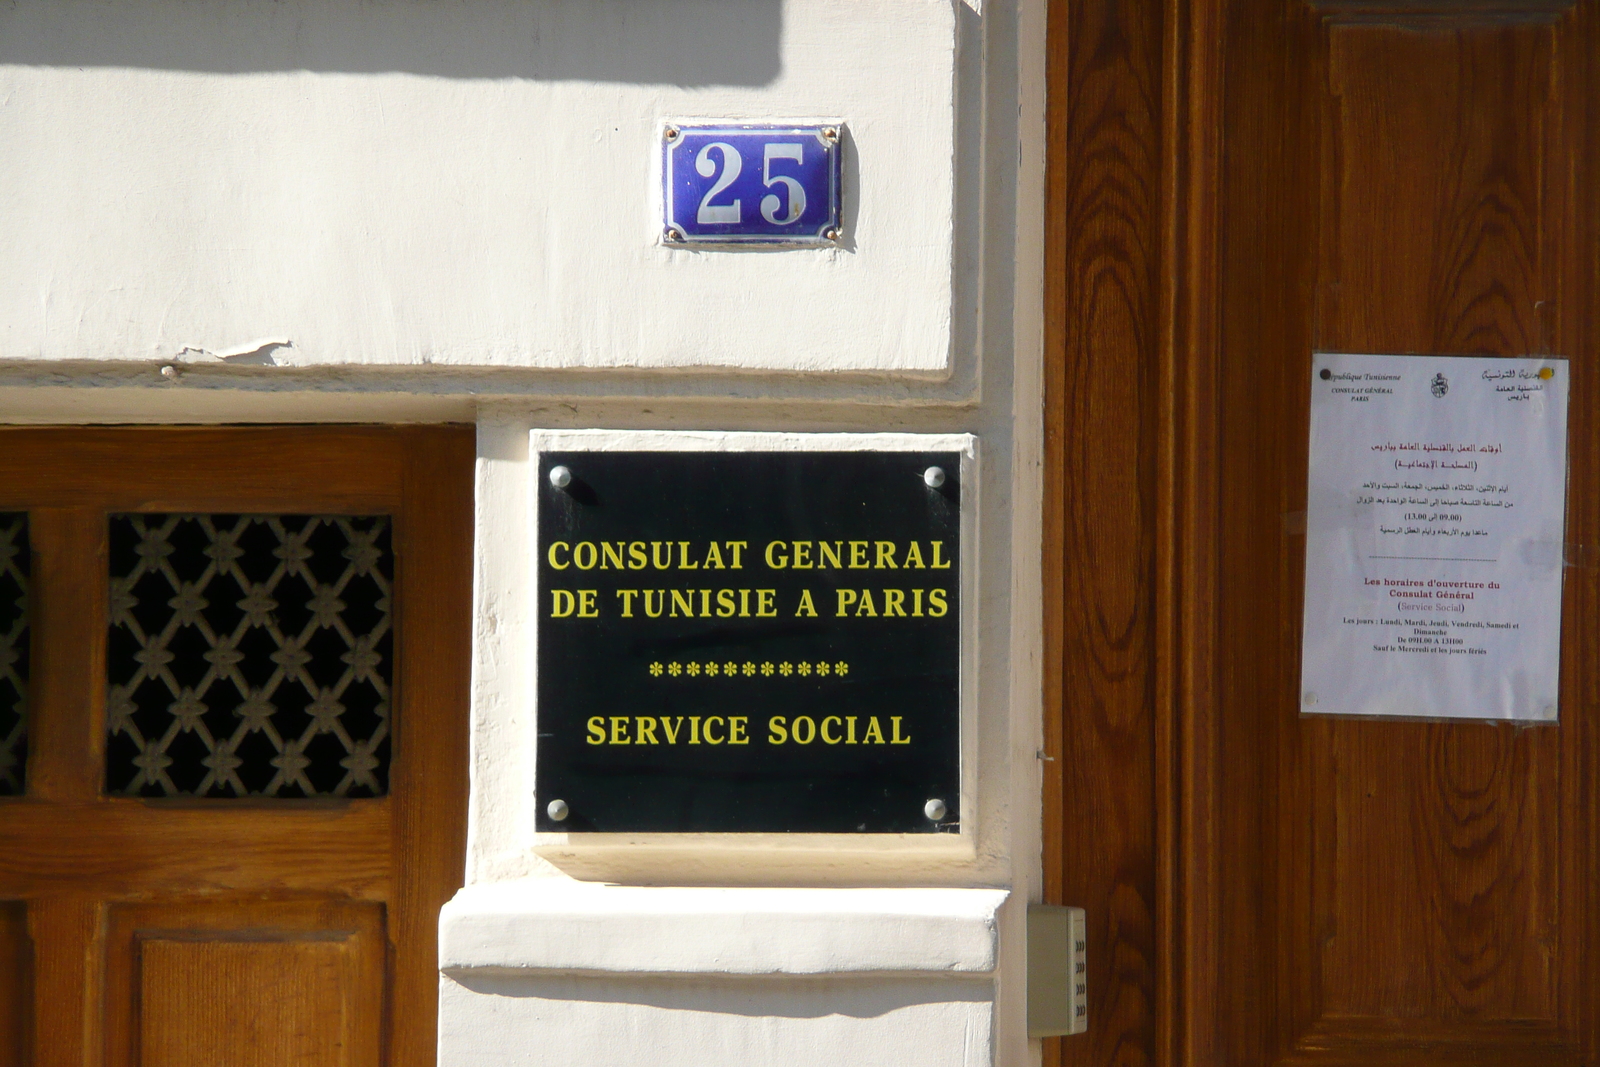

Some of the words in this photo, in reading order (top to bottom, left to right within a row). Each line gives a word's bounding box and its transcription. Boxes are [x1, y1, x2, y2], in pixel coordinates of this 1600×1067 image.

[695, 142, 806, 225] 25
[1364, 372, 1401, 381] Tunisienne
[1482, 369, 1516, 381] التونسية
[1365, 386, 1393, 394] GÉNÉRAL
[1508, 393, 1529, 401] باريس
[1371, 441, 1396, 452] بباريس
[1399, 442, 1420, 451] العامة
[1457, 443, 1476, 453] العمل
[547, 540, 749, 571] CONSULAT
[764, 540, 952, 571] GENERAL
[1364, 577, 1381, 585] Les
[1384, 578, 1424, 587] horaires
[1427, 579, 1485, 588] d'ouverture
[1488, 581, 1500, 590] du
[1389, 589, 1433, 598] Consulat
[1436, 590, 1475, 599] Général
[550, 588, 599, 618] DE
[616, 588, 777, 618] TUNISIE
[795, 588, 818, 618] A
[835, 588, 949, 618] PARIS
[1397, 601, 1433, 612] (Service
[1435, 602, 1465, 613] Social)
[1356, 617, 1374, 626] jours
[1380, 618, 1402, 627] Lundi,
[1404, 618, 1427, 627] Mardi,
[1429, 619, 1450, 628] Jeudi,
[1452, 620, 1484, 629] Vendredi,
[1486, 621, 1511, 629] Samedi
[1413, 628, 1447, 636] Dimanche
[1373, 644, 1389, 652] Sauf
[1398, 645, 1429, 653] Mercredi
[1449, 647, 1467, 655] jours
[1468, 647, 1487, 655] fériés
[586, 715, 751, 746] SERVICE
[768, 715, 911, 746] SOCIAL
